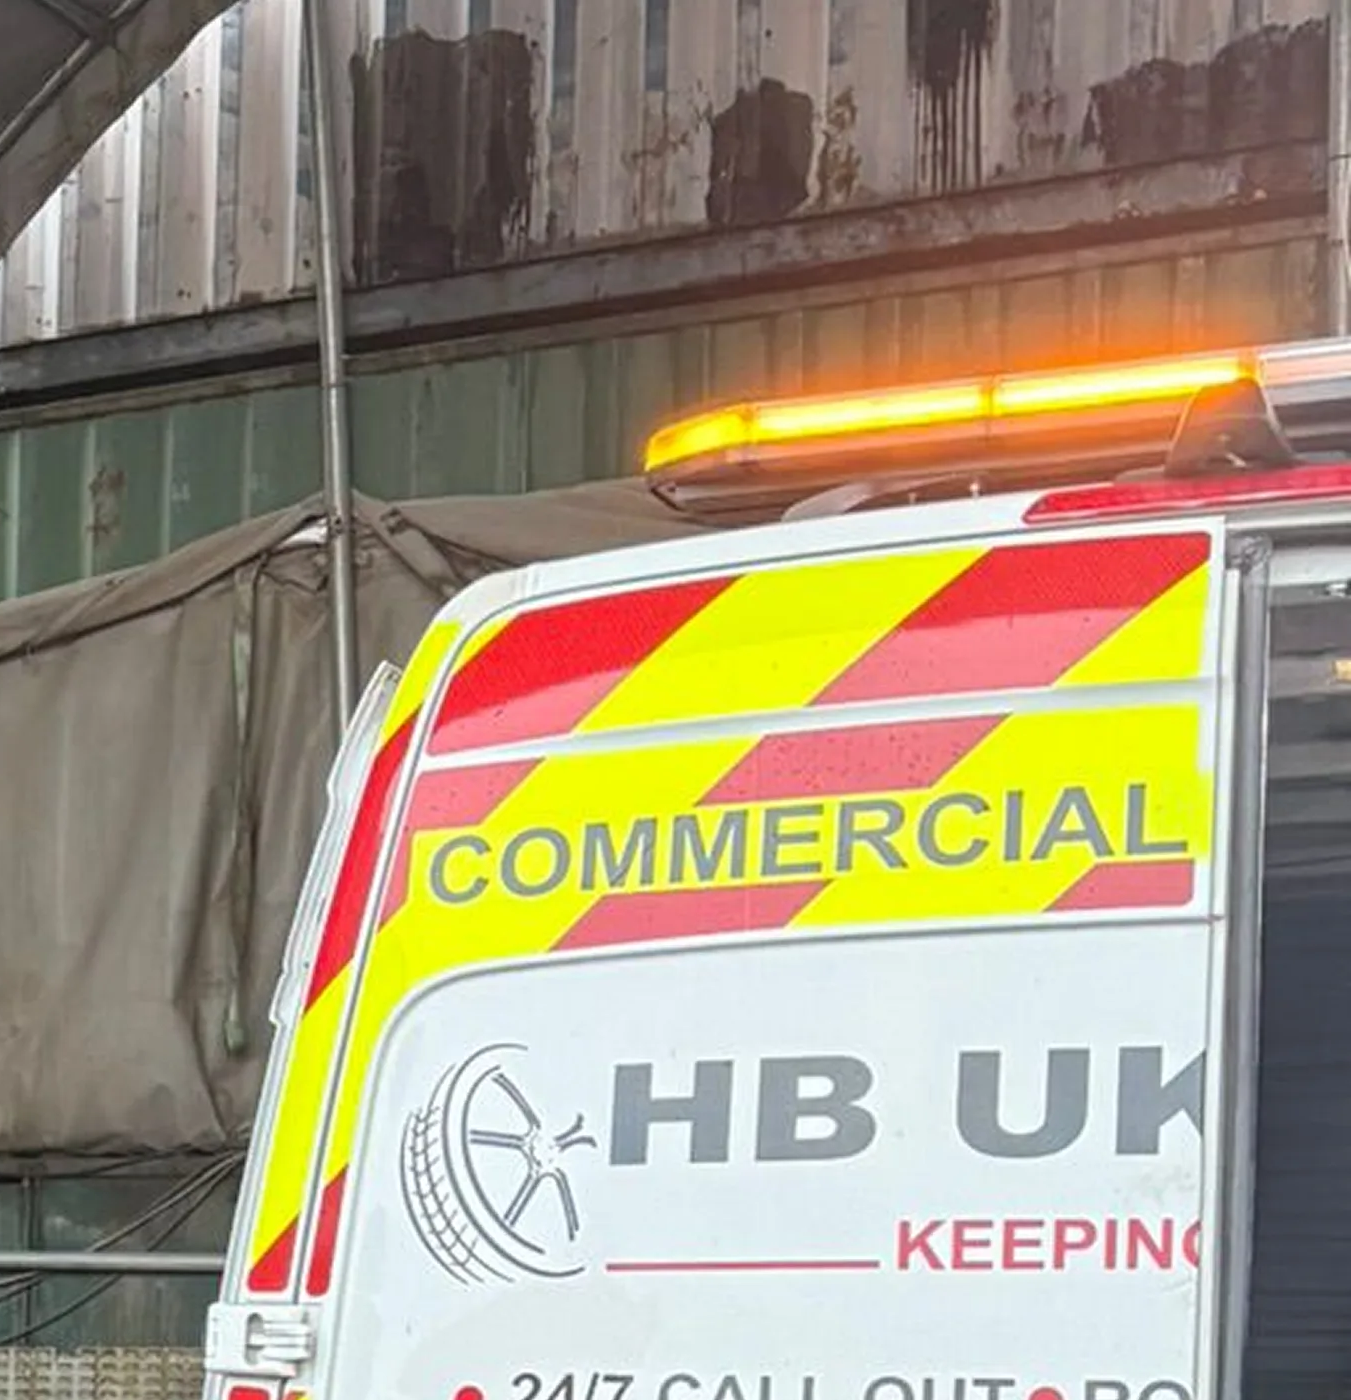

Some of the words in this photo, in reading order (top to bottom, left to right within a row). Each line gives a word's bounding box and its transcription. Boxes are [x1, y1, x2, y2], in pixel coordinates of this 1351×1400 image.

[429, 783, 1189, 905] COMMERCIAL
[606, 1055, 875, 1165] HB
[955, 1045, 1206, 1159] UK
